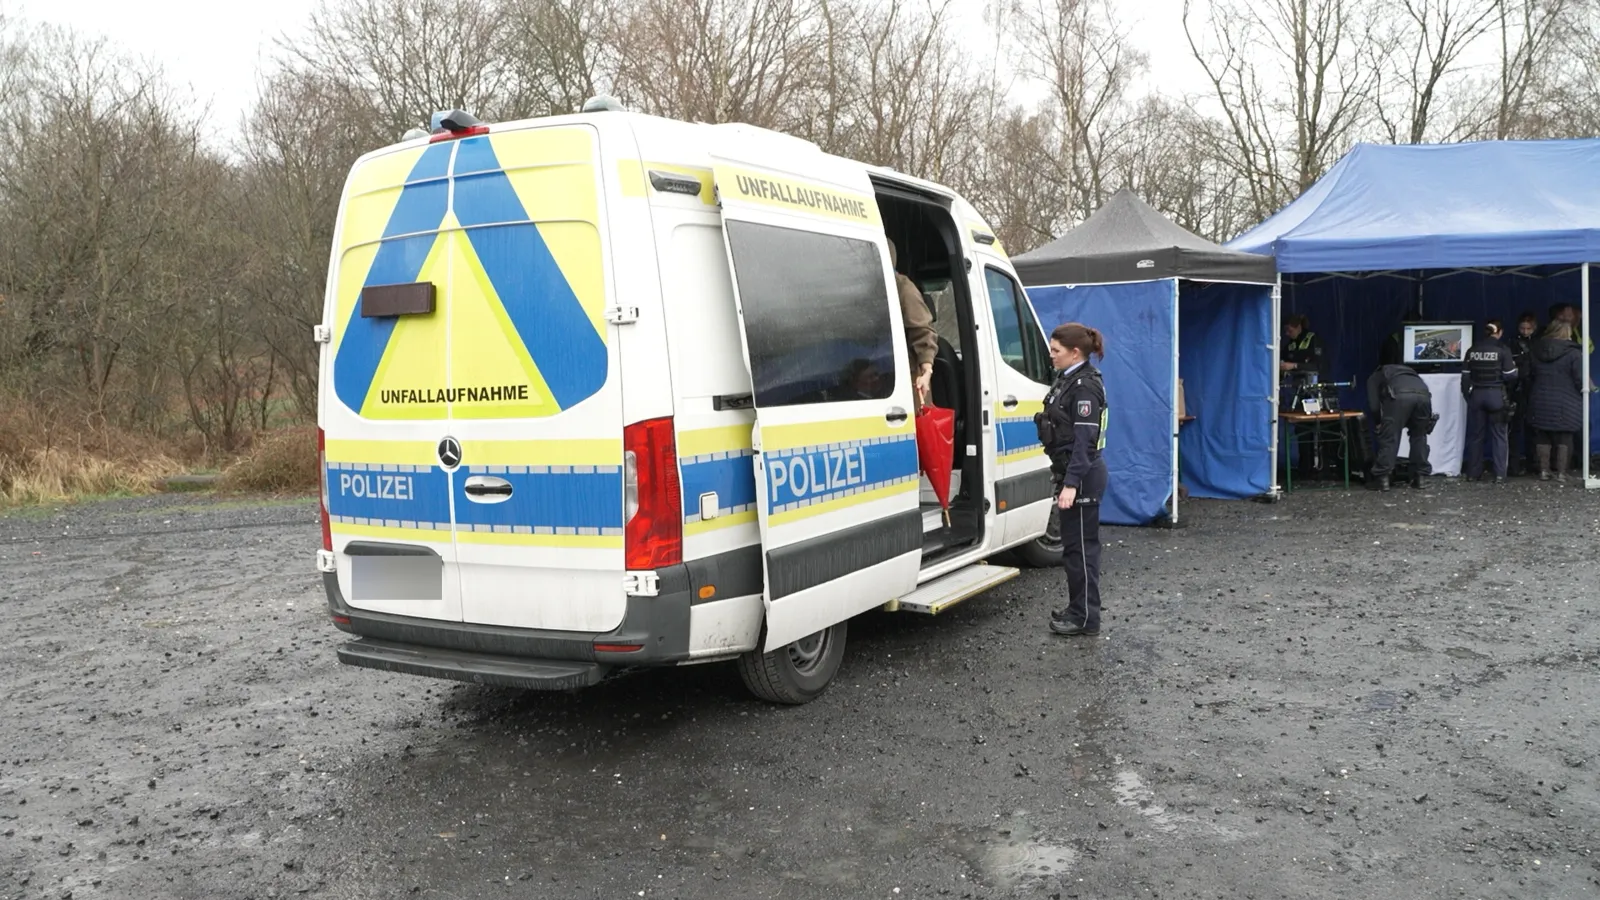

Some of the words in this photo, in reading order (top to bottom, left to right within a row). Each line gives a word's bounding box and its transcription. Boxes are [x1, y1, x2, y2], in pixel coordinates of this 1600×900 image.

[736, 174, 868, 219] UNFALLAUFNAHME
[1470, 352, 1498, 361] POLIZEI
[381, 385, 528, 404] UNFALLAUFNAHME
[341, 474, 413, 500] POLIZEI
[770, 446, 866, 502] POLIZEI
